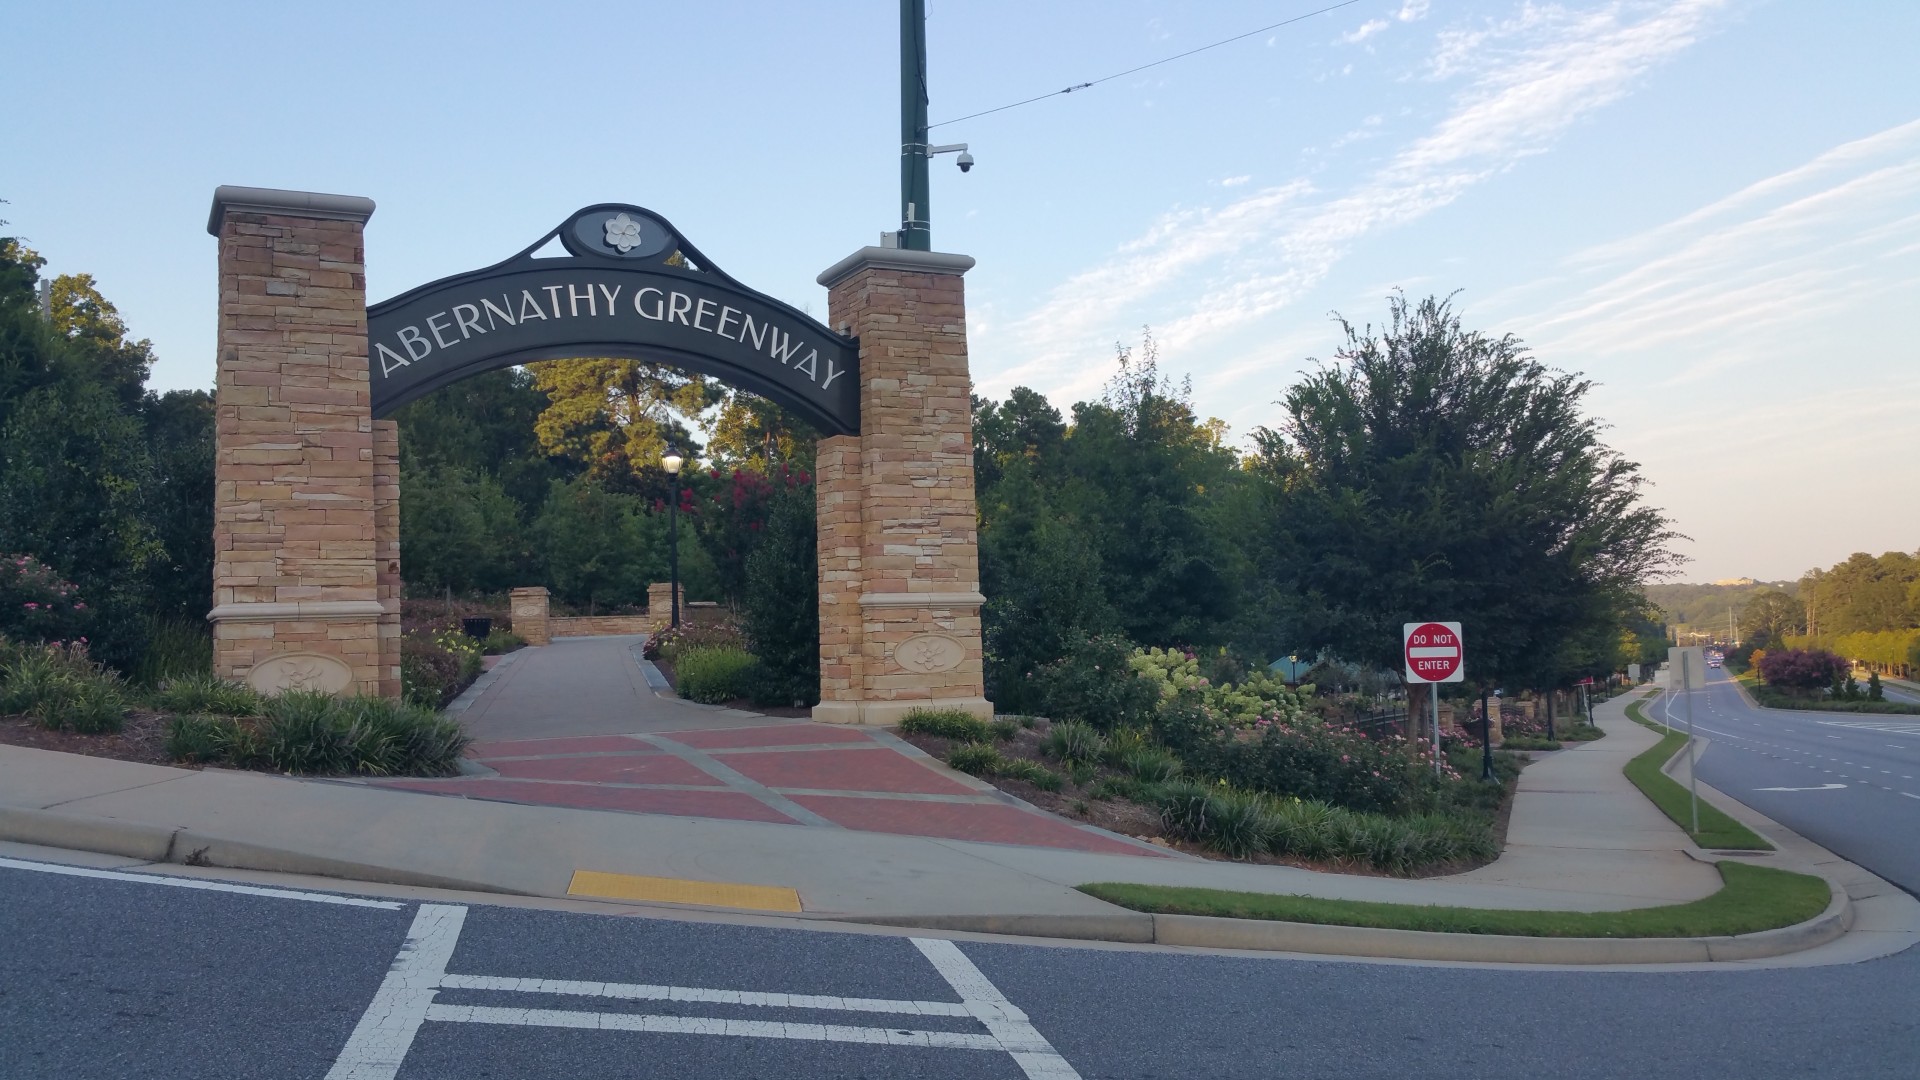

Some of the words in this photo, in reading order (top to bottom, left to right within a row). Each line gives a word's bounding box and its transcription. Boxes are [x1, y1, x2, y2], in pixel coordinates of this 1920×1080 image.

[374, 284, 621, 378] ABERNATHY
[634, 287, 846, 391] GREENWAY
[1414, 635, 1427, 645] DO
[1433, 634, 1453, 644] NOT
[1418, 660, 1450, 670] ENTER
